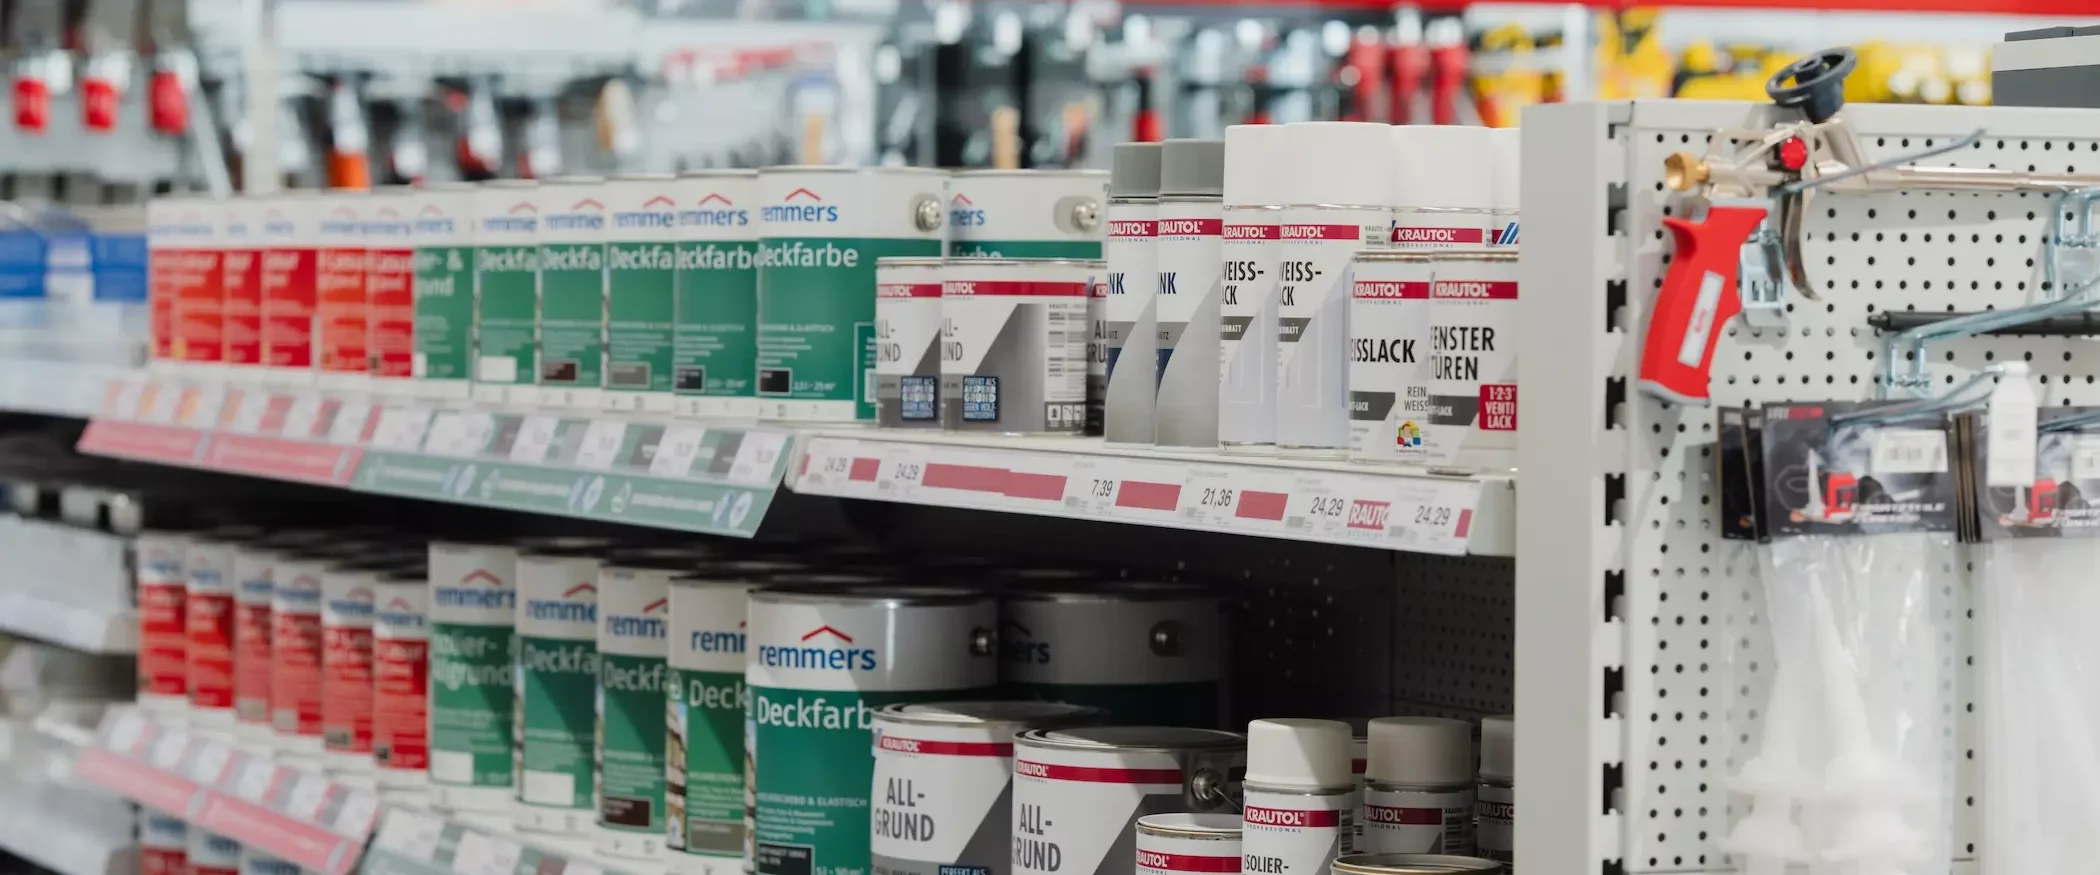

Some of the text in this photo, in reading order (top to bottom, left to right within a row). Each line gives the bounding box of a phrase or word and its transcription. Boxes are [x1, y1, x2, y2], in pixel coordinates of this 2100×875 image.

[1398, 229, 1454, 242] KRAUTOL
[878, 285, 912, 297] AUTOL
[1355, 282, 1402, 298] KRAUTOL
[1436, 282, 1489, 298] KRAUTOL
[1407, 386, 1426, 398] REIN
[1485, 401, 1515, 416] VENTI
[1487, 415, 1513, 429] LACK
[895, 462, 919, 481] 24,29
[1091, 479, 1113, 498] 7,39
[1202, 488, 1233, 509] 21,36
[1310, 497, 1344, 517] 24,29
[1415, 505, 1452, 526] 24,29
[759, 644, 877, 671] remmers
[887, 777, 925, 808] ALL-
[875, 807, 935, 842] GRUND
[1019, 803, 1053, 836] ALL-
[1247, 807, 1302, 825] KRAUTOL
